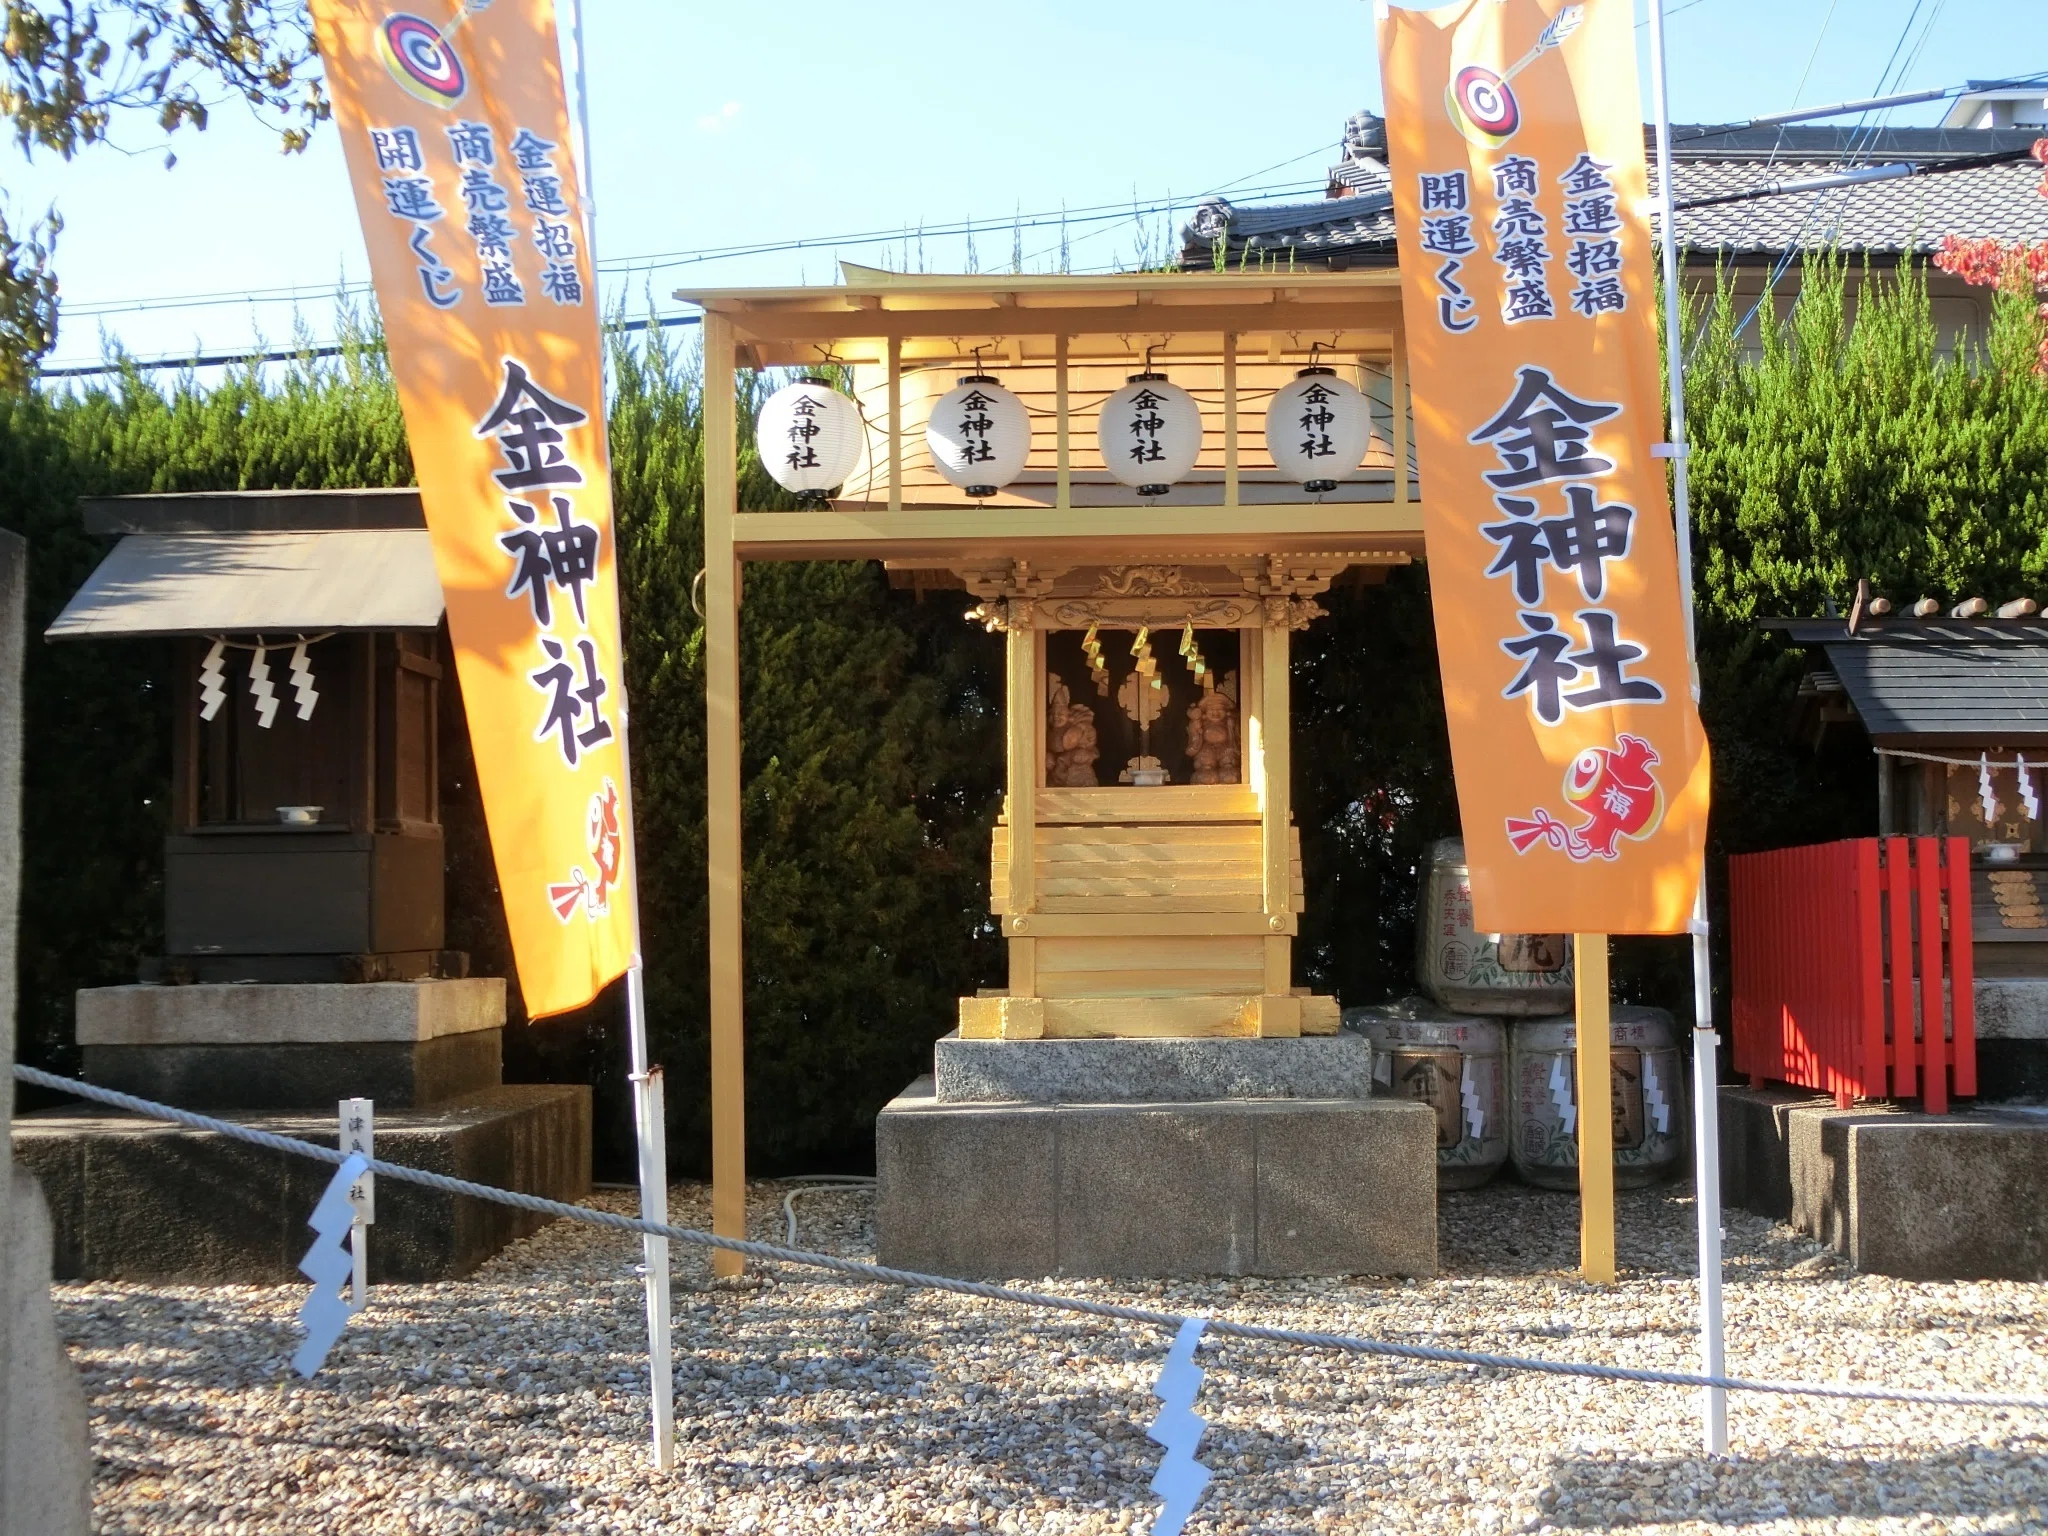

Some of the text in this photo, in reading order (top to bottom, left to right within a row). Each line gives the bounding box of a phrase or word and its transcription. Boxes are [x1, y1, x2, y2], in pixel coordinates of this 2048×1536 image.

[371, 129, 460, 306] 開運くじ
[449, 122, 524, 304] 商売繁盛
[510, 131, 582, 304] 金運招福
[1421, 173, 1477, 330] 開運くじ
[1493, 158, 1553, 321] 商売繁盛
[1561, 156, 1625, 314] 金運招福
[786, 394, 826, 470] 金神社
[959, 389, 999, 465] 金神社
[1129, 388, 1169, 465] 金神社
[1298, 383, 1339, 459] 金神社
[477, 361, 613, 765] 金神社
[1470, 368, 1663, 723] 金神社
[1600, 784, 1634, 820] 福
[349, 1116, 365, 1200] 津島社
